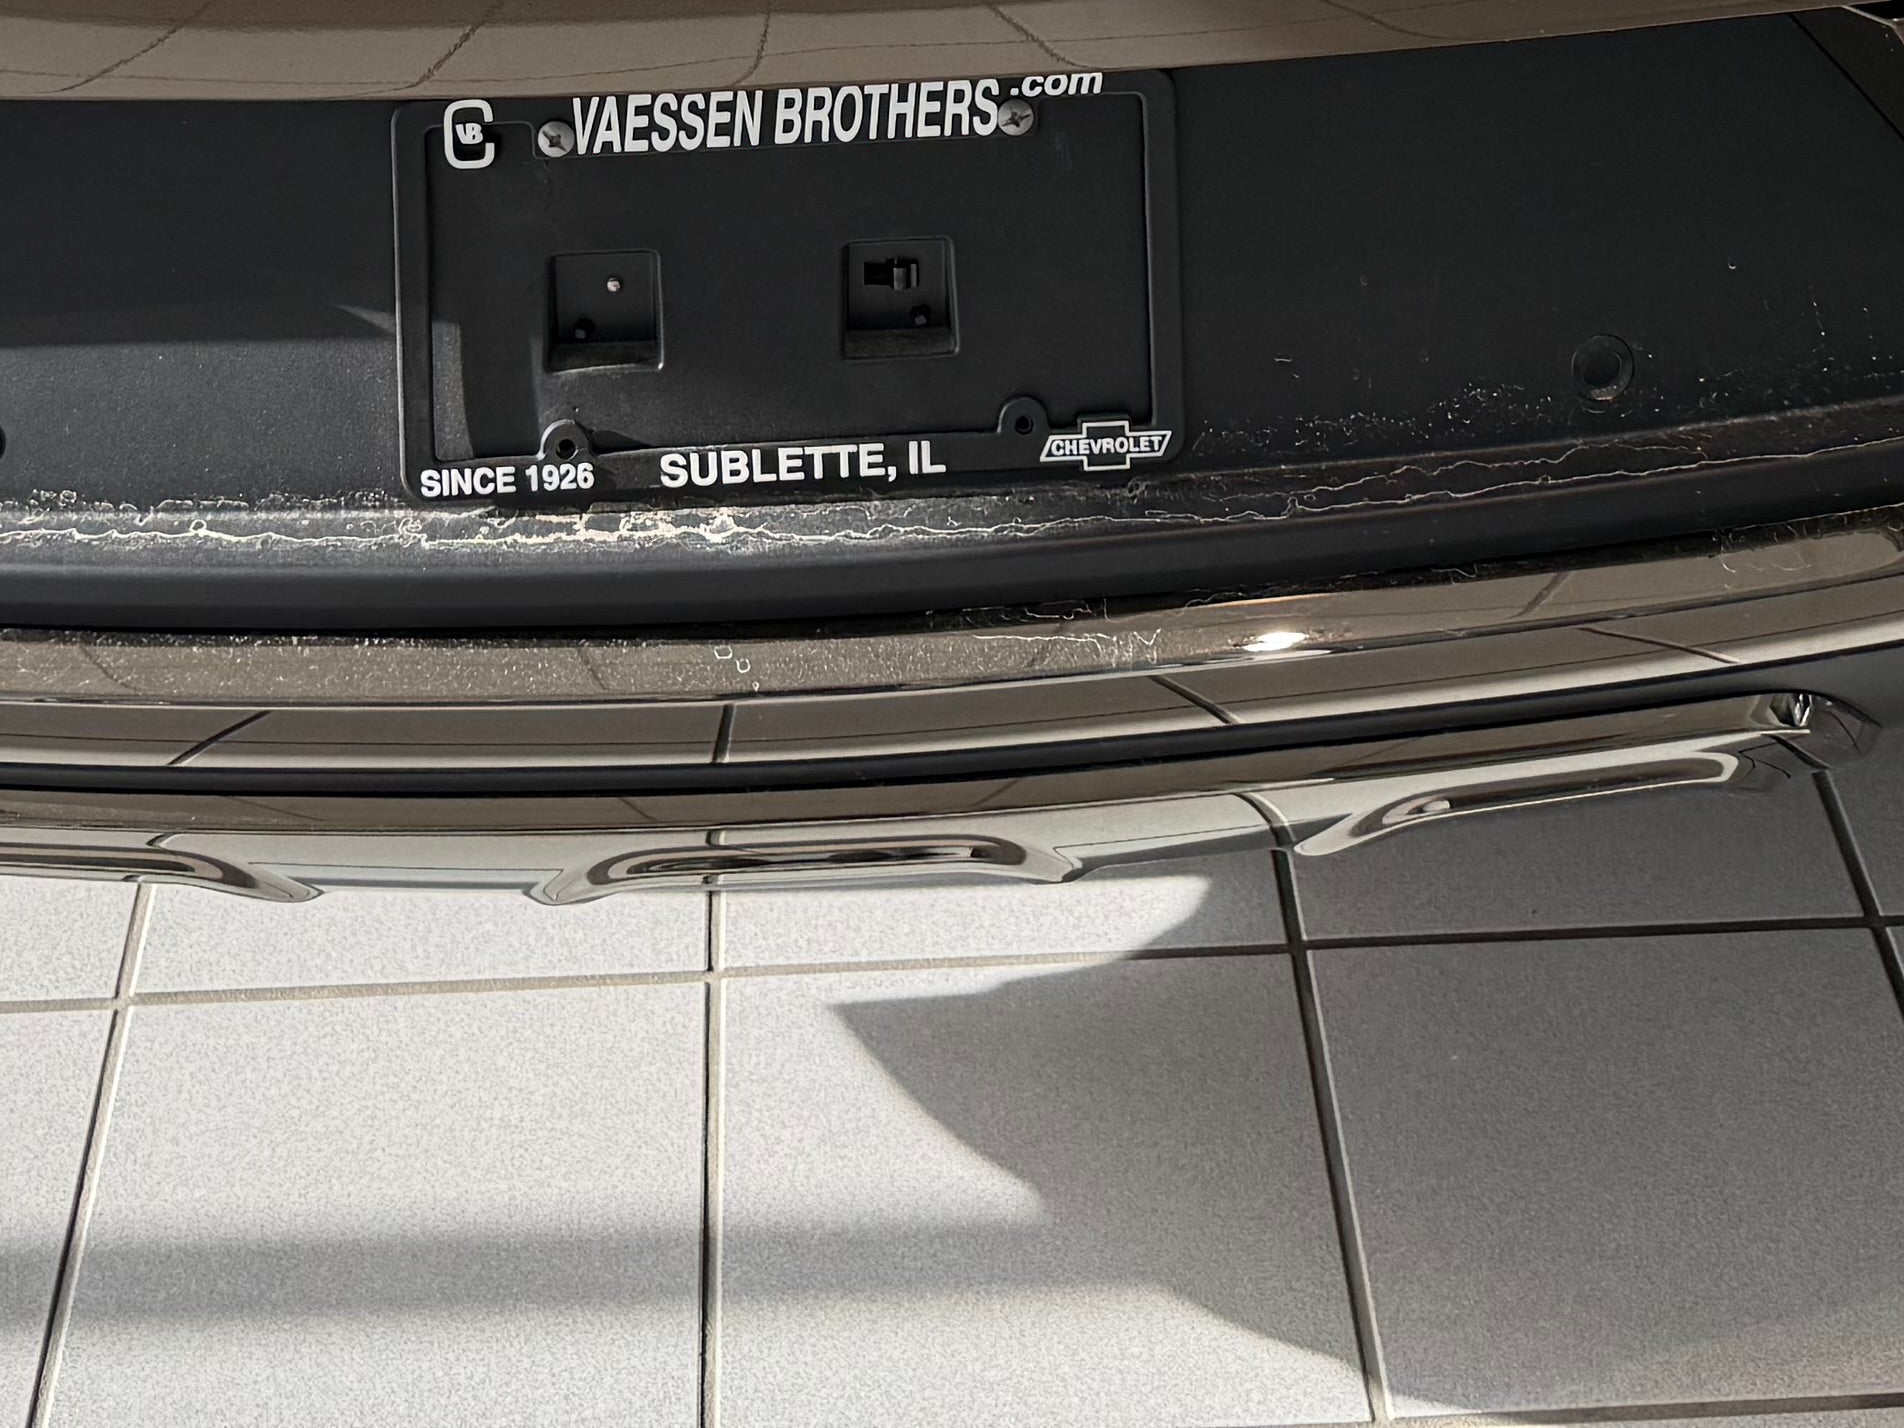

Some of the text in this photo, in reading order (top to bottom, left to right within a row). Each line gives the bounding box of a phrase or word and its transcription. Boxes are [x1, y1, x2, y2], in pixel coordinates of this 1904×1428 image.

[572, 71, 1104, 156] VAESSEN BROTHERS .com
[659, 440, 947, 489] SUBLETTE, IL
[1050, 435, 1164, 456] CHEVROLET
[419, 461, 596, 498] SINCE 1926
